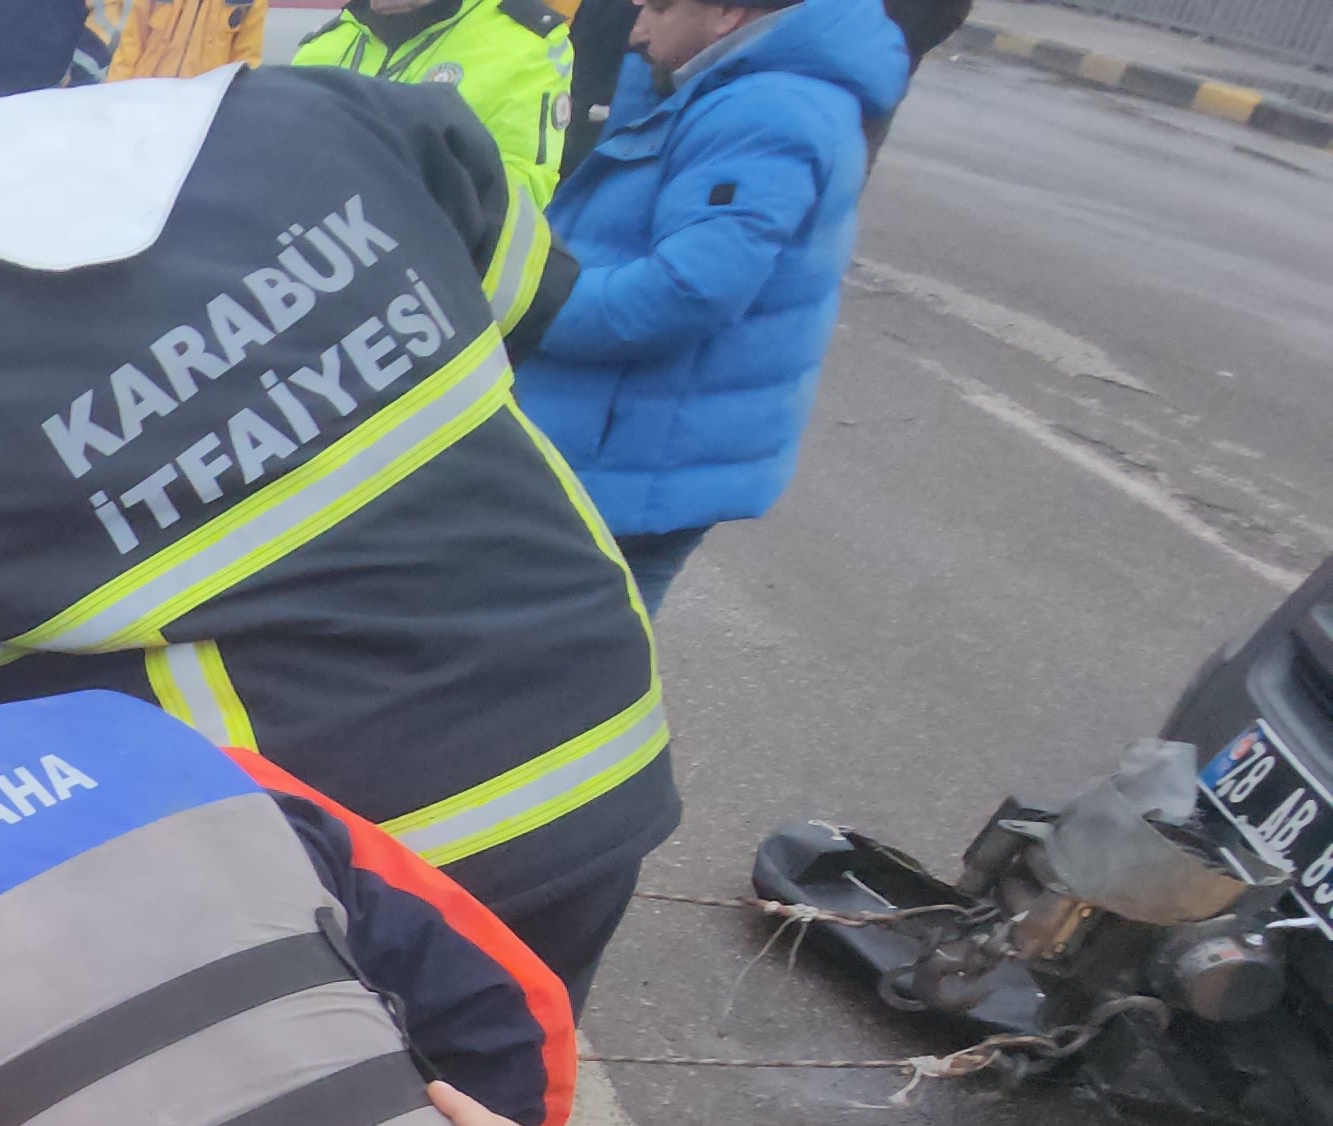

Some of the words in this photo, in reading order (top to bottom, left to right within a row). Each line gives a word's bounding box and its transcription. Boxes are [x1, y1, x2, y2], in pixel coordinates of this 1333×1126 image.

[40, 193, 400, 480] KARABÜK
[88, 267, 457, 556] İTFAİYESİ
[1257, 787, 1319, 851] AB
